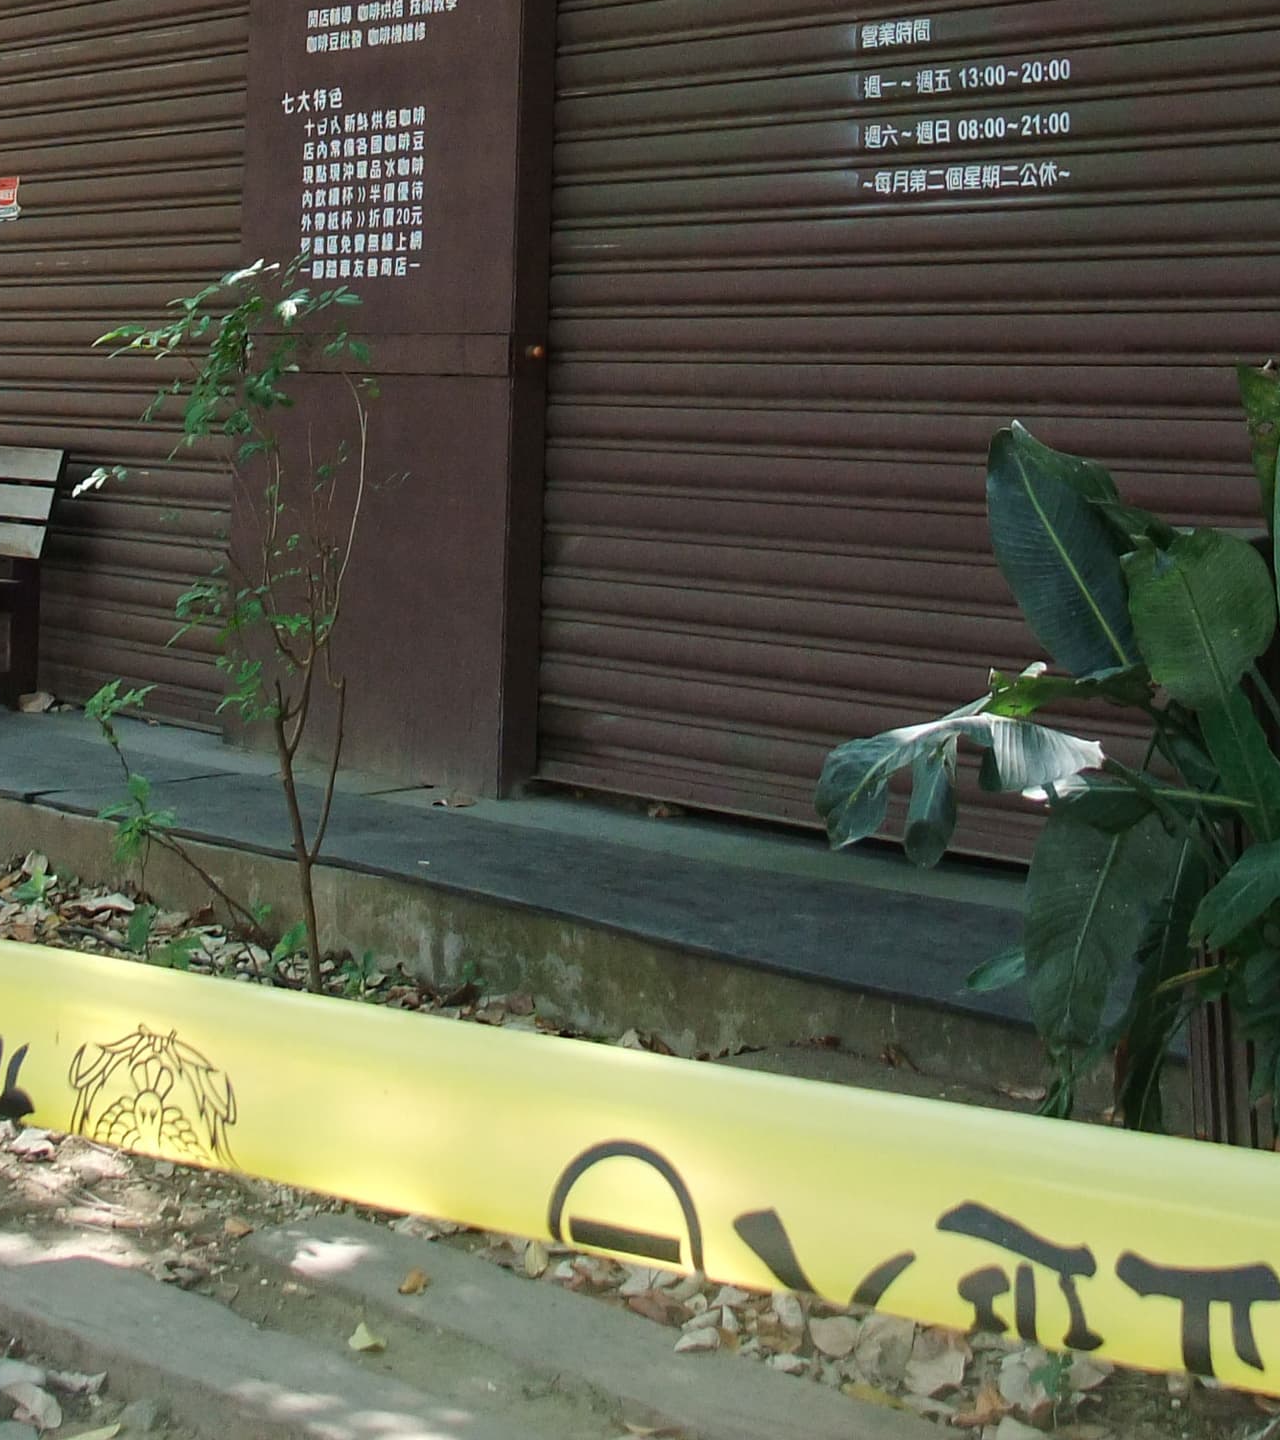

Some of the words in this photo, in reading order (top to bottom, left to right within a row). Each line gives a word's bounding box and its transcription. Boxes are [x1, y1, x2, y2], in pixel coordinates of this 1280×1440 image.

[861, 18, 931, 49] 營業時間
[281, 87, 343, 114] 七大特色
